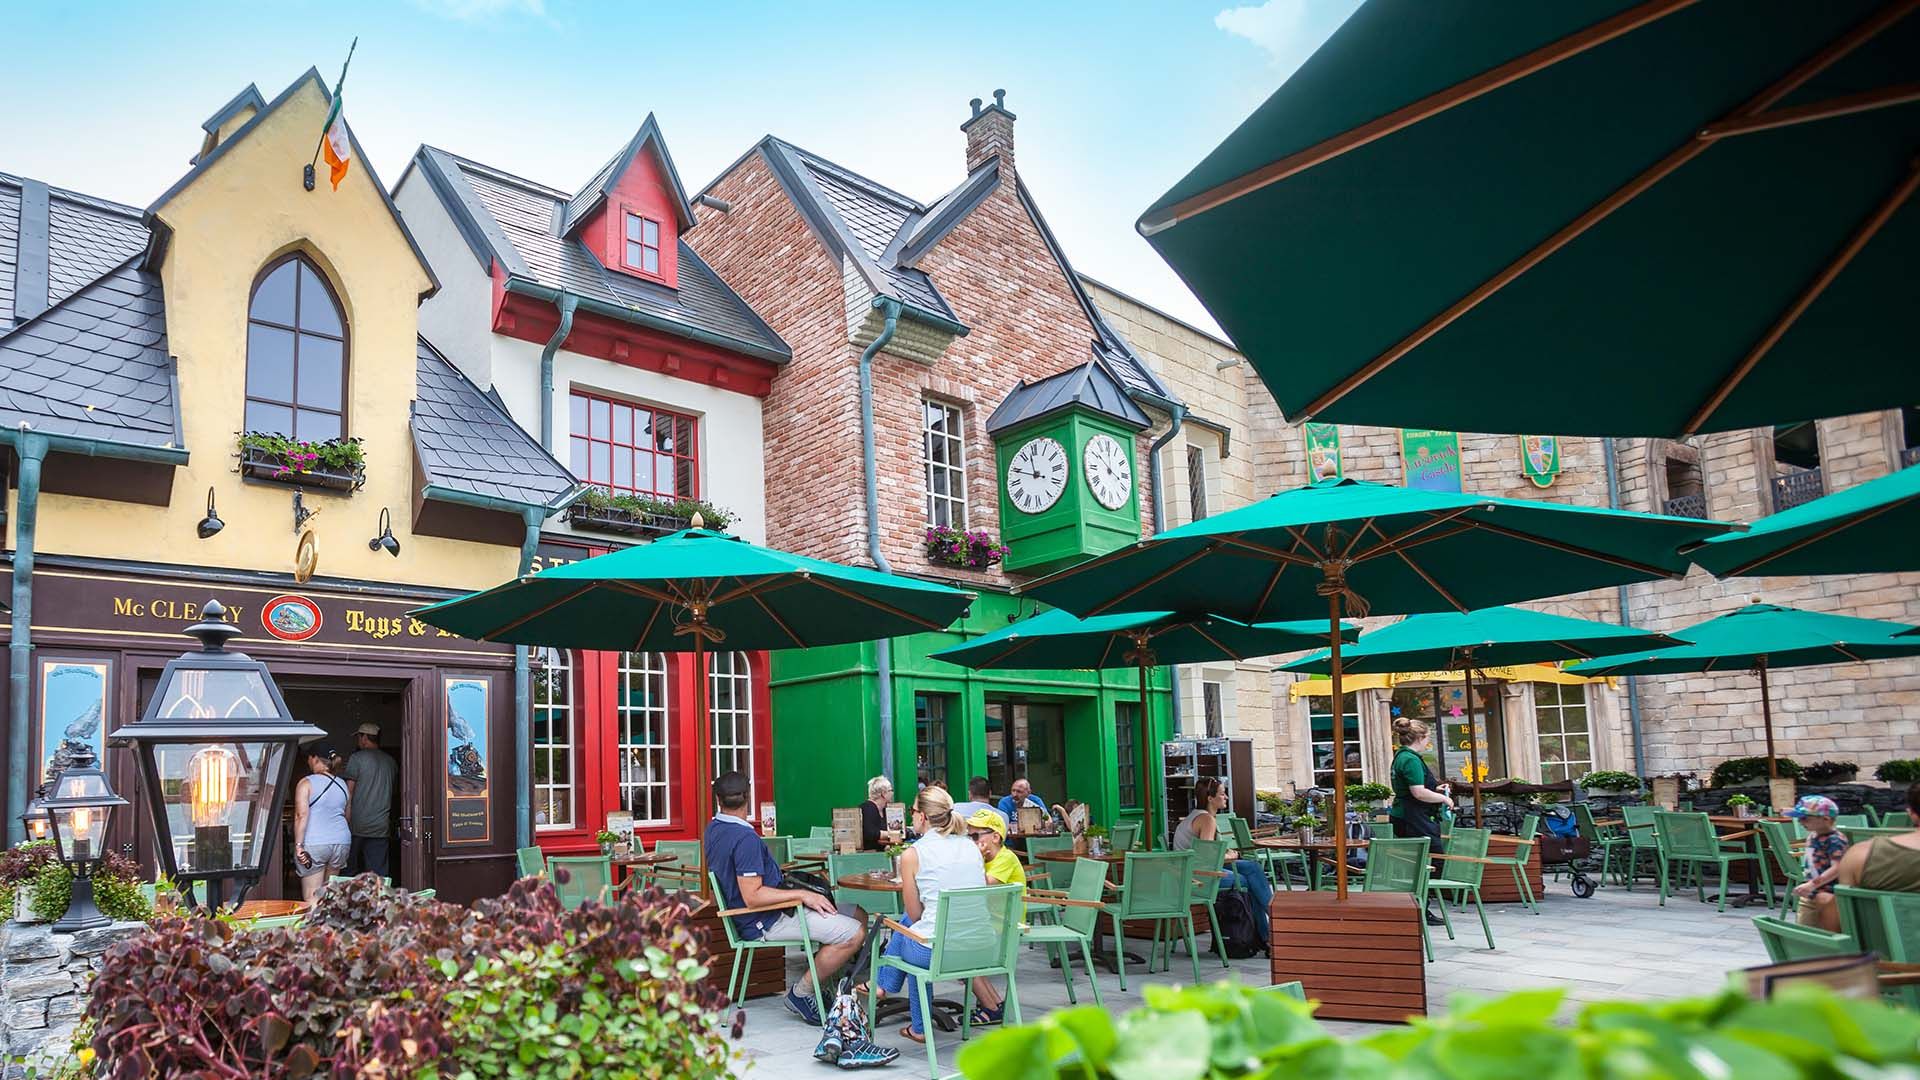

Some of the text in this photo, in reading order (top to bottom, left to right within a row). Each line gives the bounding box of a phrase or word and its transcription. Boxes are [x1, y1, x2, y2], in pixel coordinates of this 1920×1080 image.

[113, 598, 144, 617] Mc
[151, 600, 244, 624] CLERY
[346, 609, 402, 639] Toys
[408, 617, 427, 636] &
